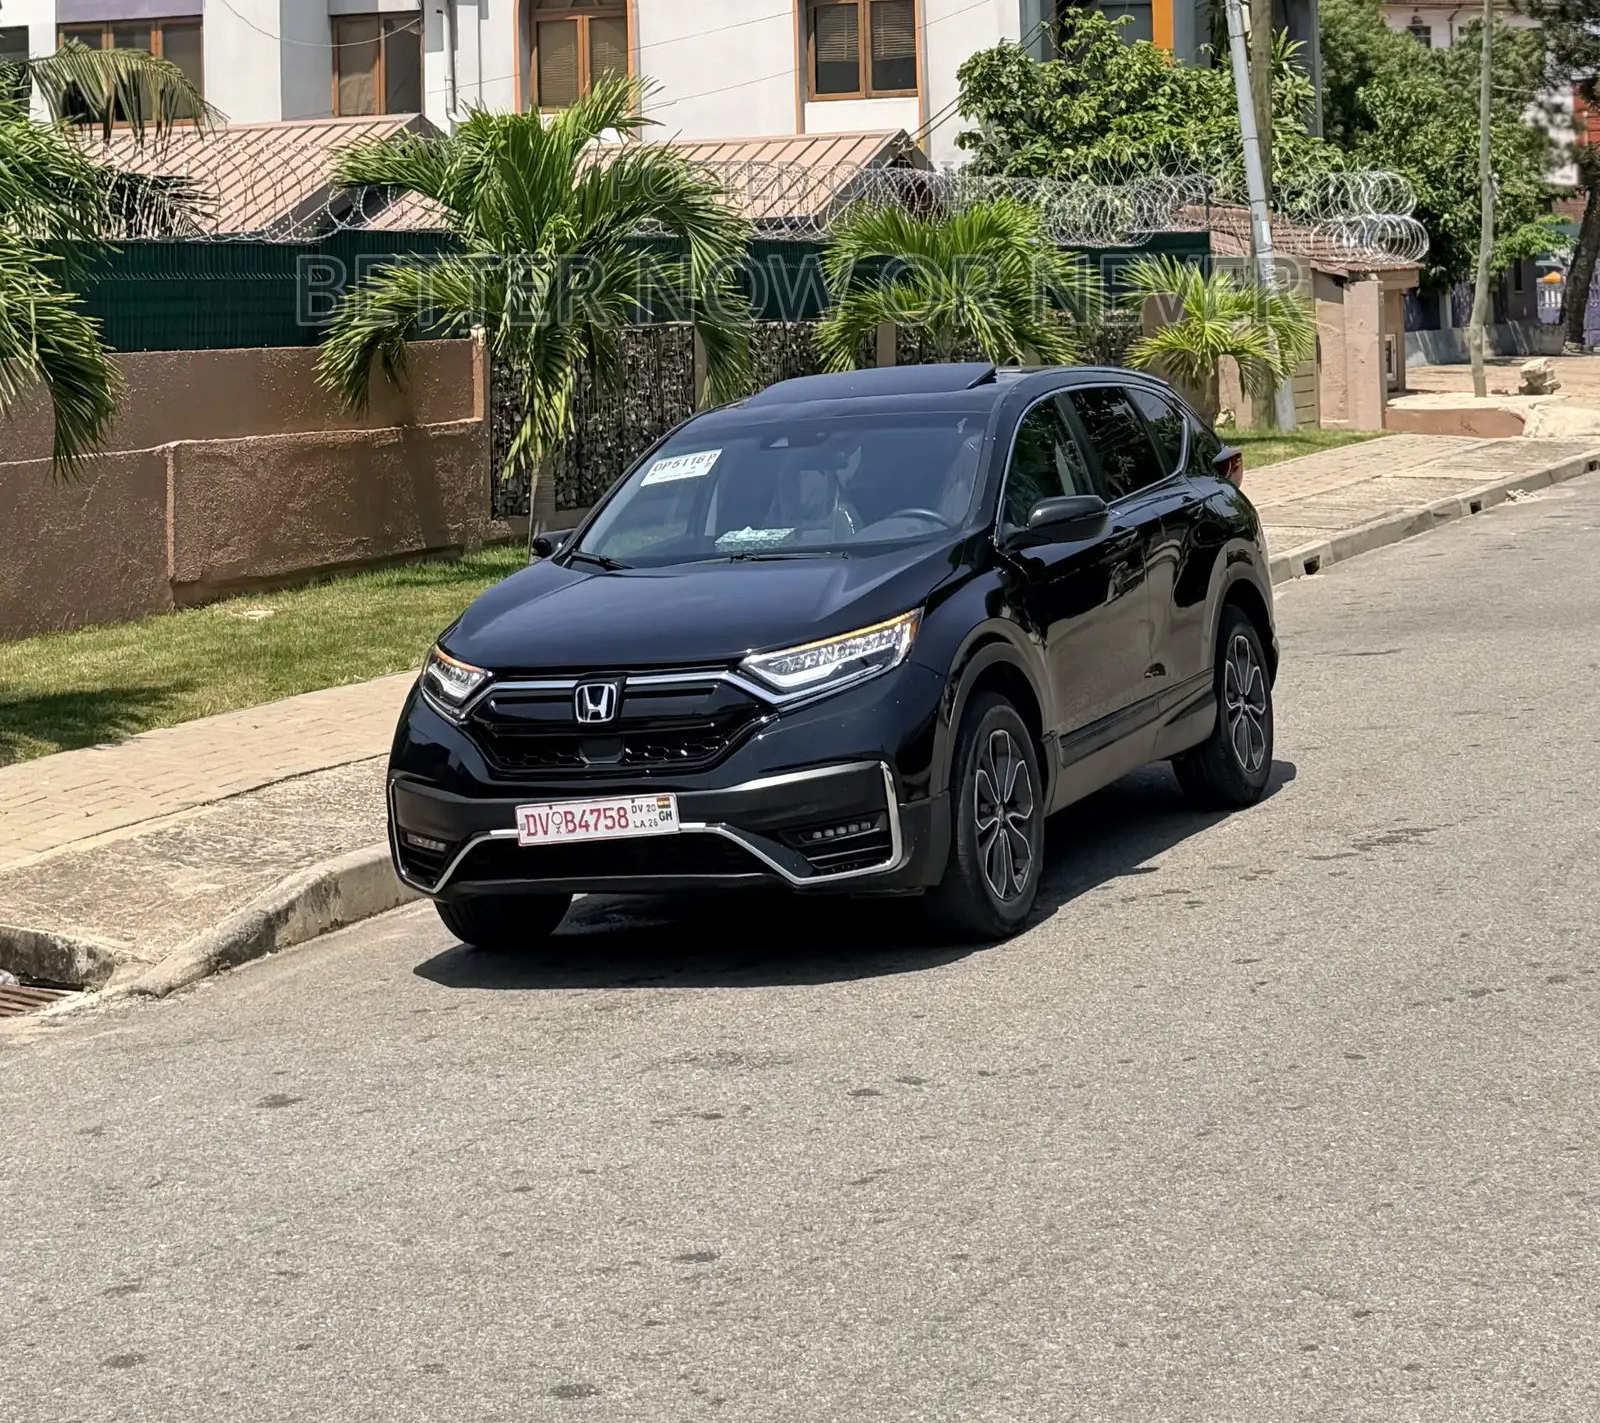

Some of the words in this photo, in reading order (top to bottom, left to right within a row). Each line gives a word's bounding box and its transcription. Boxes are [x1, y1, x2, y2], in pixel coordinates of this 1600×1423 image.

[631, 804, 643, 814] DV
[646, 803, 657, 812] 20
[525, 811, 549, 836] DV
[564, 806, 629, 834] B4758
[658, 810, 673, 822] GH
[633, 819, 647, 828] LA
